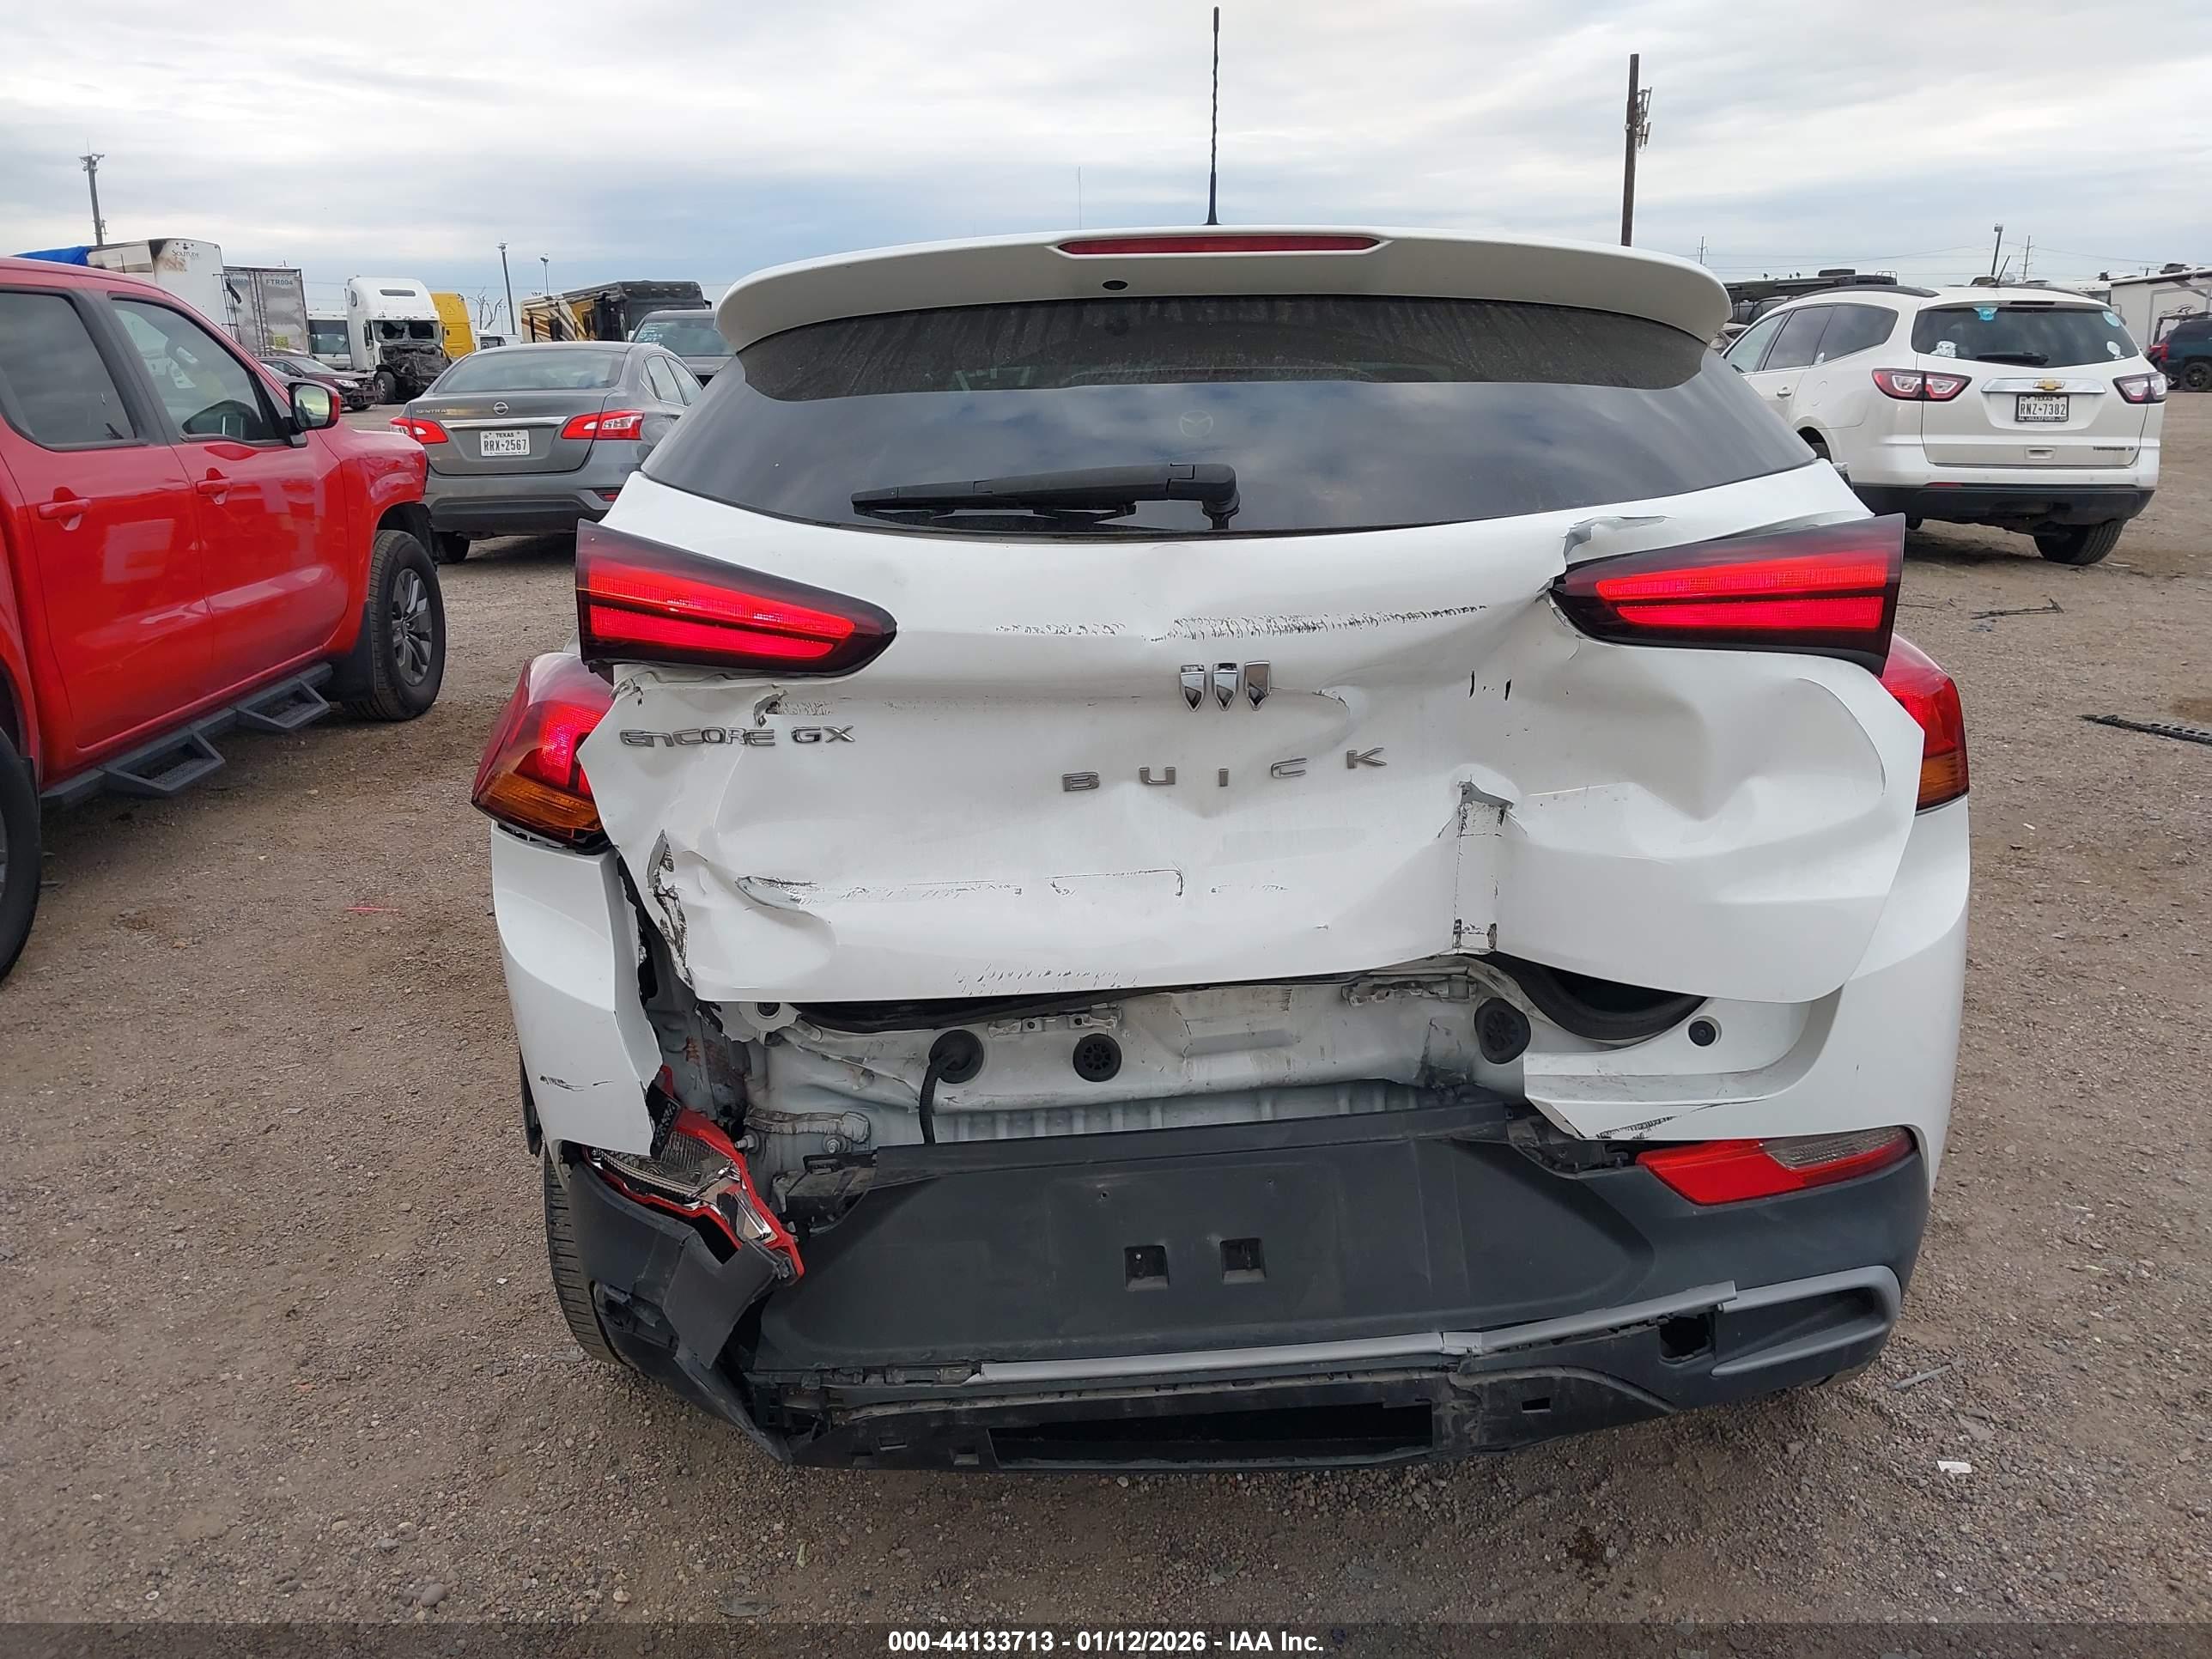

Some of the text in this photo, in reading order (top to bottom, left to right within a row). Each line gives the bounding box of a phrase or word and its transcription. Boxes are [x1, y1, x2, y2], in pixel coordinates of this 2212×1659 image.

[619, 726, 855, 747] ENCORE GX
[1061, 746, 1388, 792] BUICK
